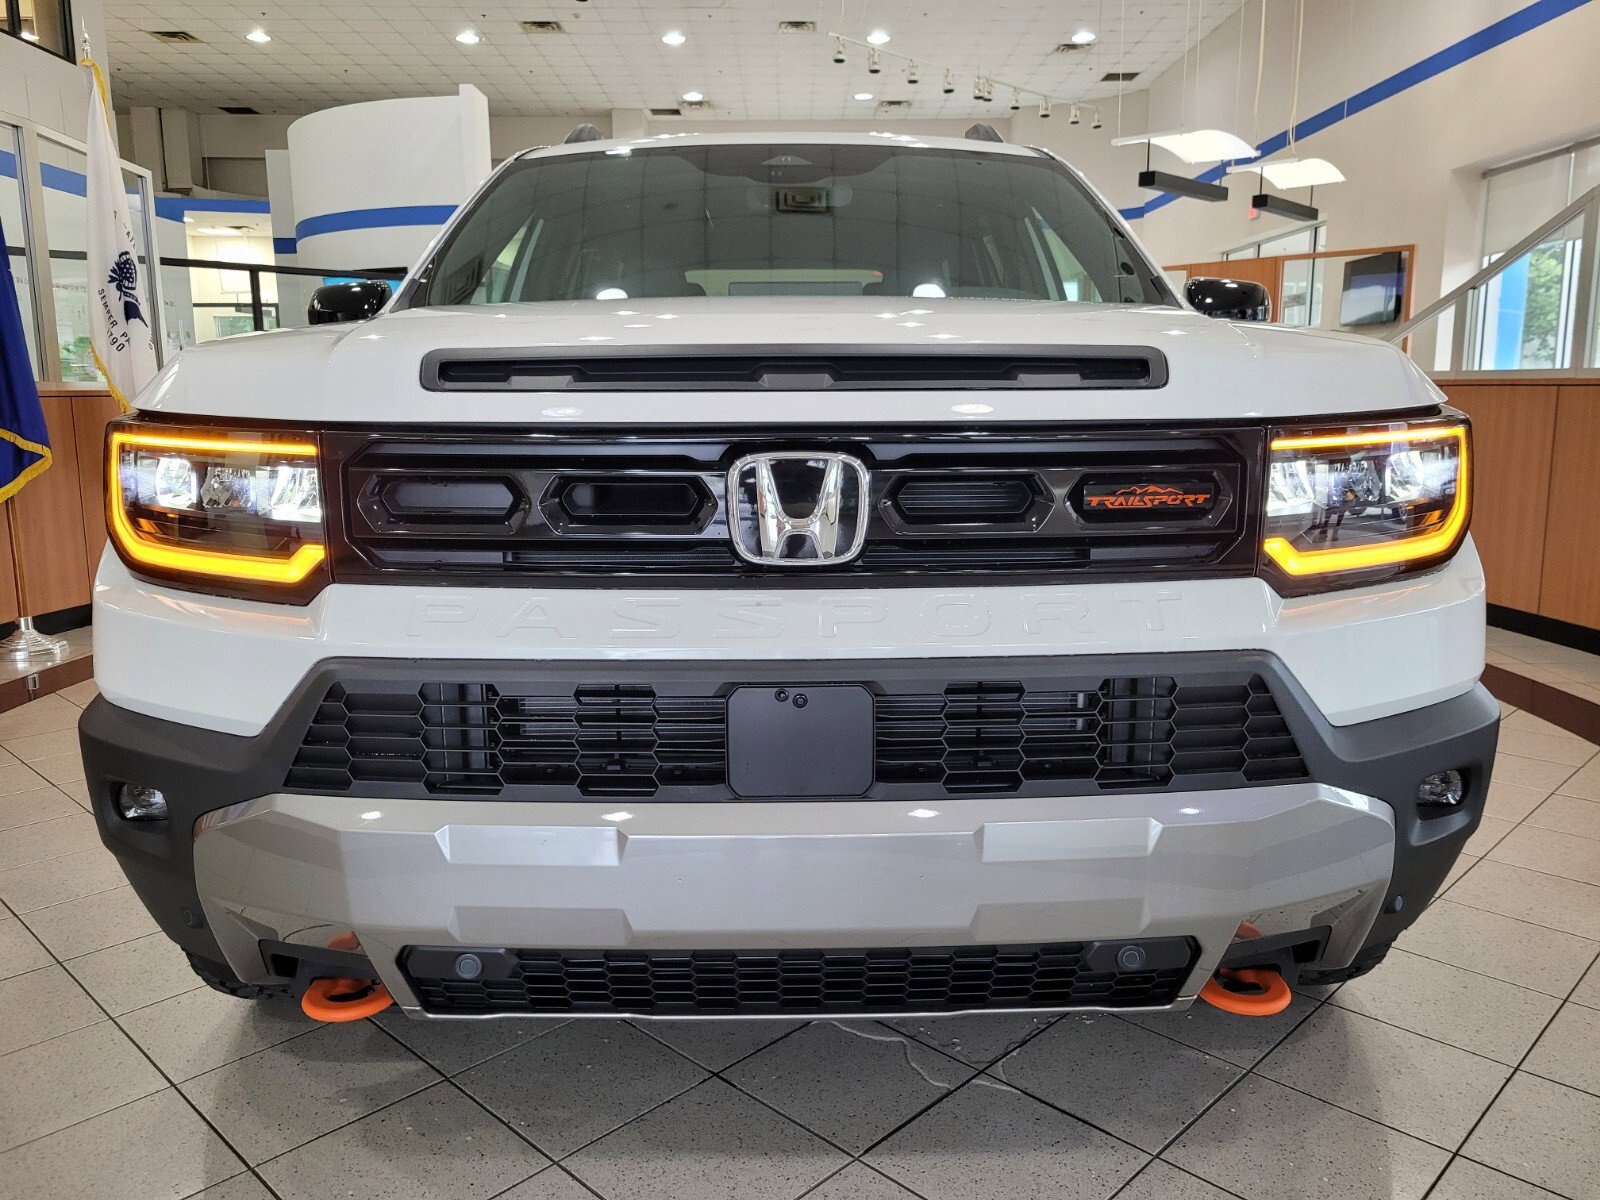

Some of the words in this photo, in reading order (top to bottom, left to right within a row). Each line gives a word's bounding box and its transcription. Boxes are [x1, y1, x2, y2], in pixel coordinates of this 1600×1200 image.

[97, 288, 119, 329] SEMPER
[1087, 494, 1211, 509] TRAILSPORT
[405, 590, 1183, 640] PASSPORT
